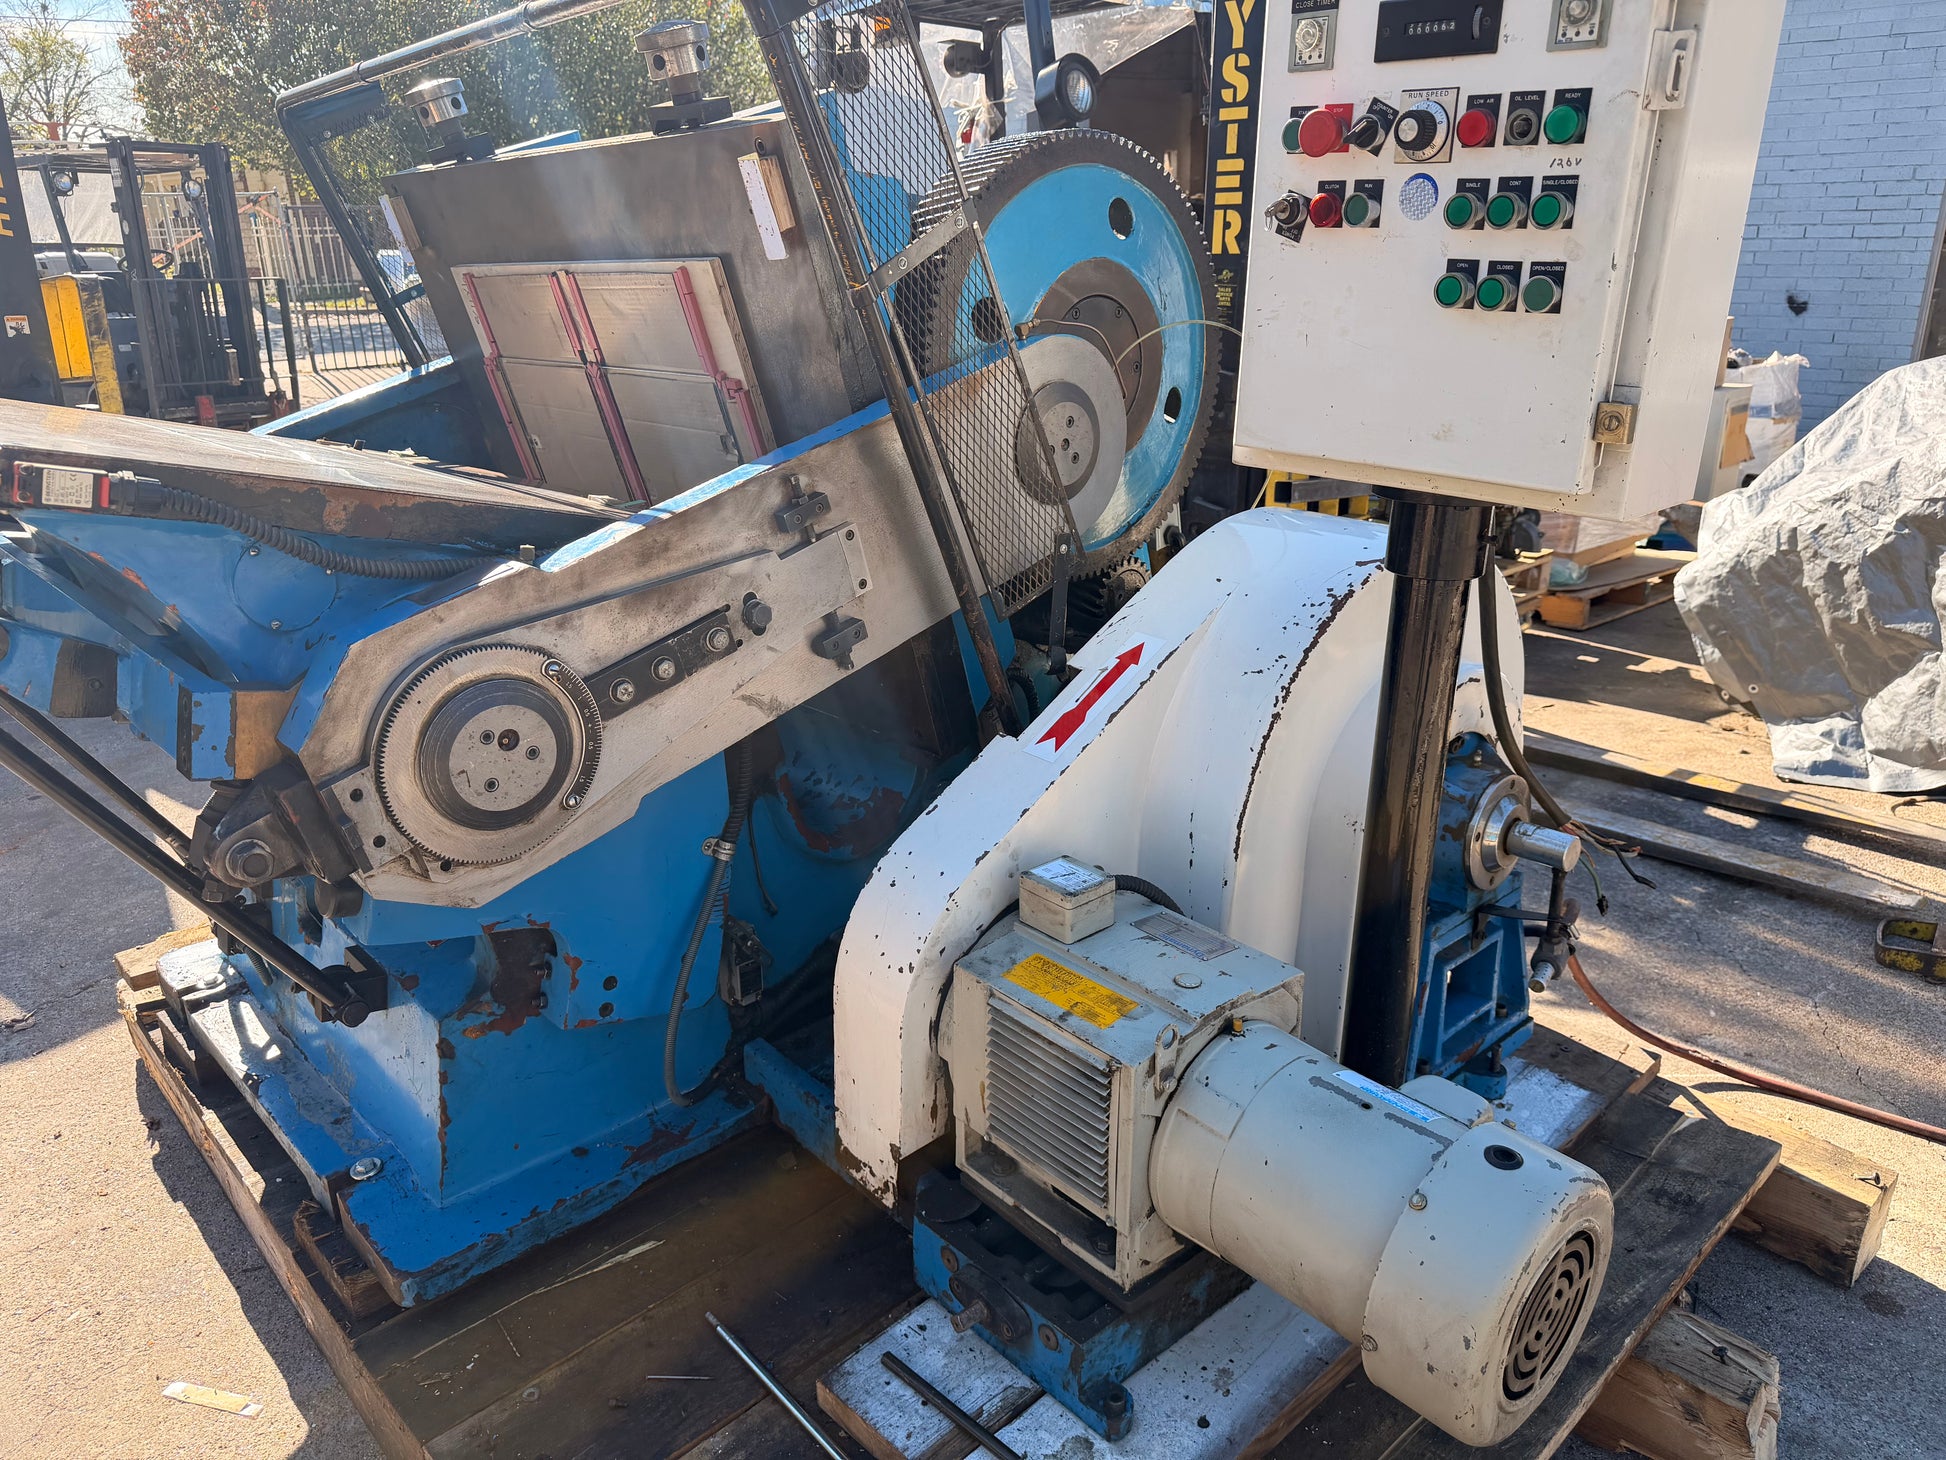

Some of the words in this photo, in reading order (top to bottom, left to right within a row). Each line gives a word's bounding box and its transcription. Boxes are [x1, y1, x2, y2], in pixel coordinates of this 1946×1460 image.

[1295, 1, 1314, 9] CLOSE
[1408, 91, 1425, 99] RUN
[1425, 90, 1449, 98] SPEED
